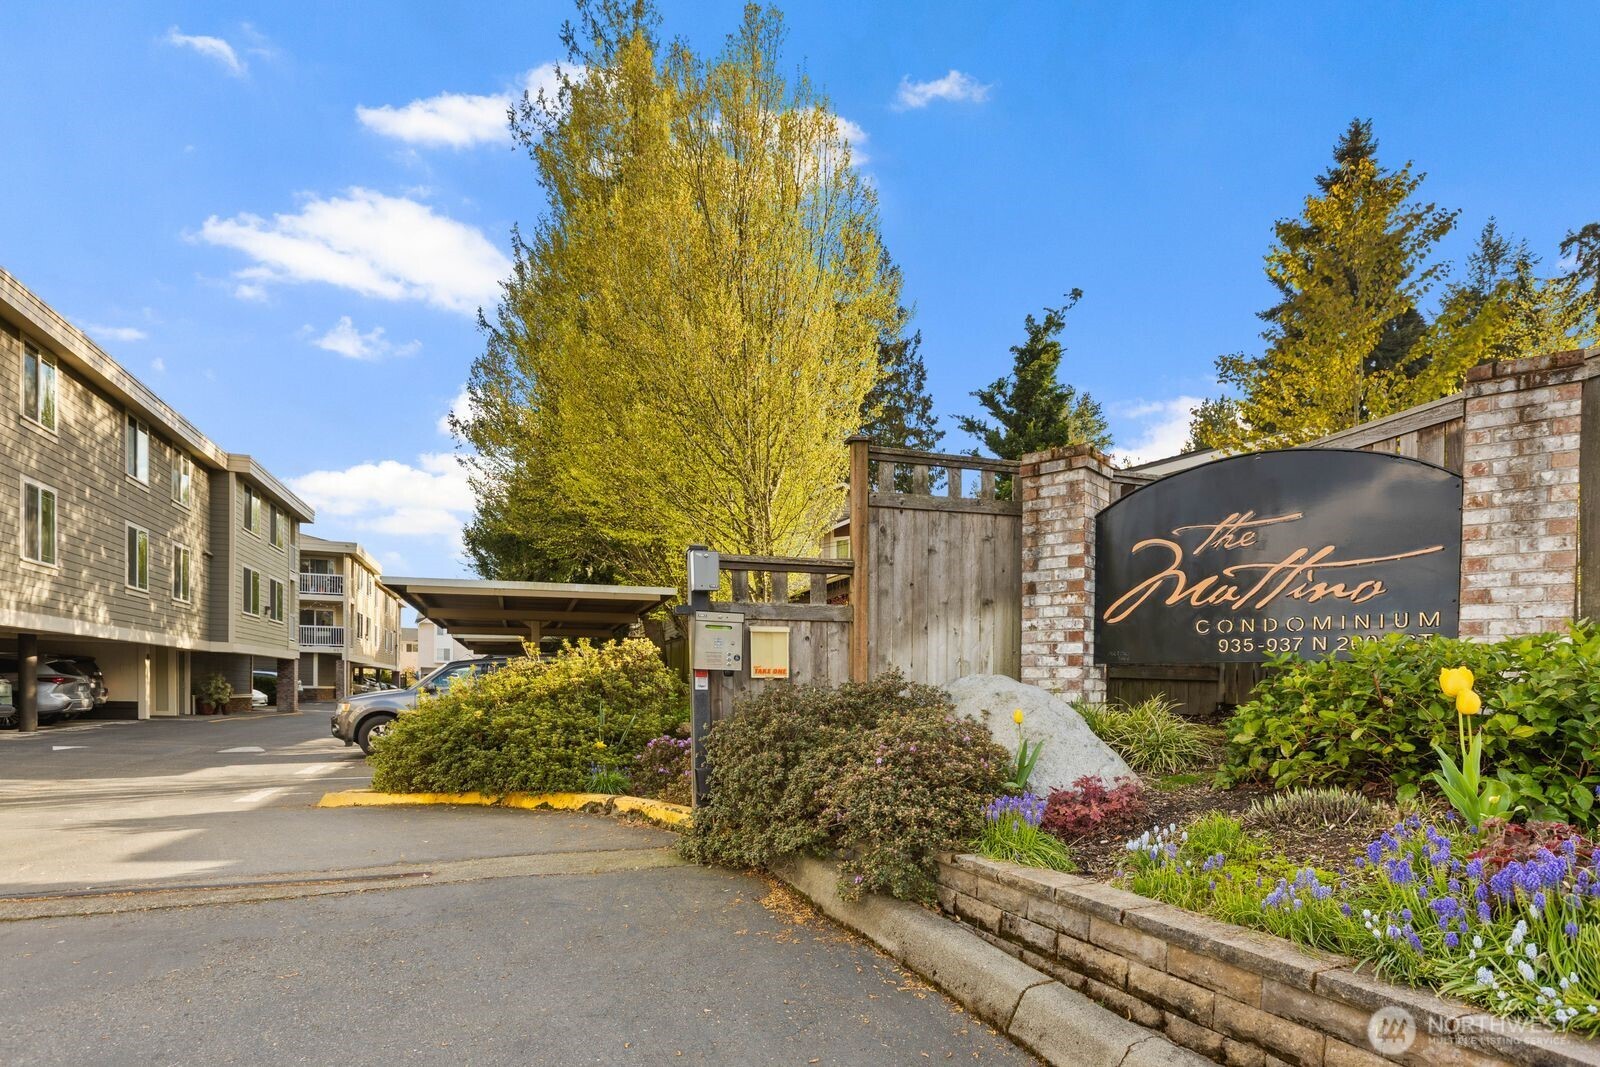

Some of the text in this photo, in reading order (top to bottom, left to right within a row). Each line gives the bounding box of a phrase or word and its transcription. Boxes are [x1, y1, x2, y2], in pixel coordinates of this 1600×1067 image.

[1171, 510, 1303, 556] the
[1103, 544, 1445, 624] Mattino
[1196, 611, 1441, 635] CONDOMINIUM
[1218, 637, 1304, 653] 935-937
[1312, 635, 1328, 651] N
